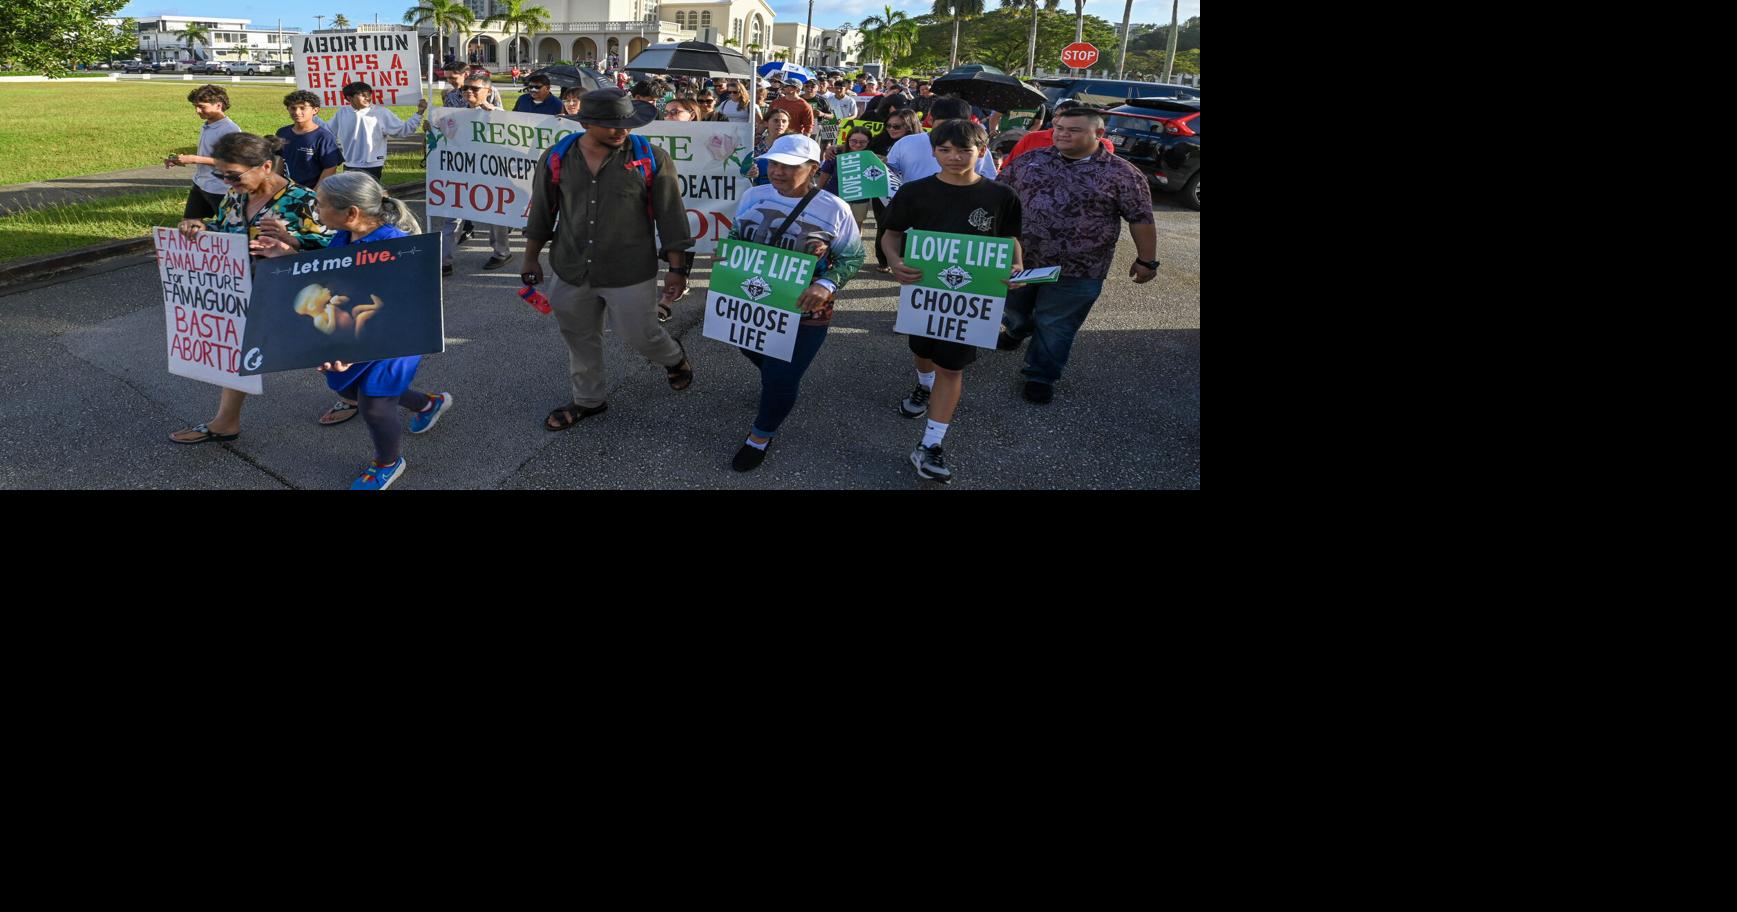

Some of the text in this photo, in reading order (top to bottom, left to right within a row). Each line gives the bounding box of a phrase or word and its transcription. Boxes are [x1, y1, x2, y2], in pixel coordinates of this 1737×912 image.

[303, 34, 408, 53] ABORTION
[1063, 50, 1096, 60] STOP
[307, 54, 402, 71] STOPS A
[308, 70, 409, 88] BEATING
[324, 89, 399, 106] HERT
[440, 150, 475, 174] FROM
[678, 174, 736, 200] DEATH
[841, 153, 862, 199] LOVE LIFE
[428, 180, 515, 215] STOP
[157, 228, 230, 255] FANACHU
[910, 235, 1009, 269] LOVE LIFE
[292, 249, 396, 276] Let me live.
[719, 243, 811, 285] LOVE LIFE
[188, 270, 246, 293] FUTURE
[163, 281, 250, 317] FAMAGUON
[910, 288, 993, 320] CHOOSE
[175, 306, 239, 345] BASTA
[715, 296, 789, 334] CHOOSE
[926, 314, 968, 341] LIFE
[729, 323, 767, 351] LIFE
[170, 334, 242, 373] ABORTIO
